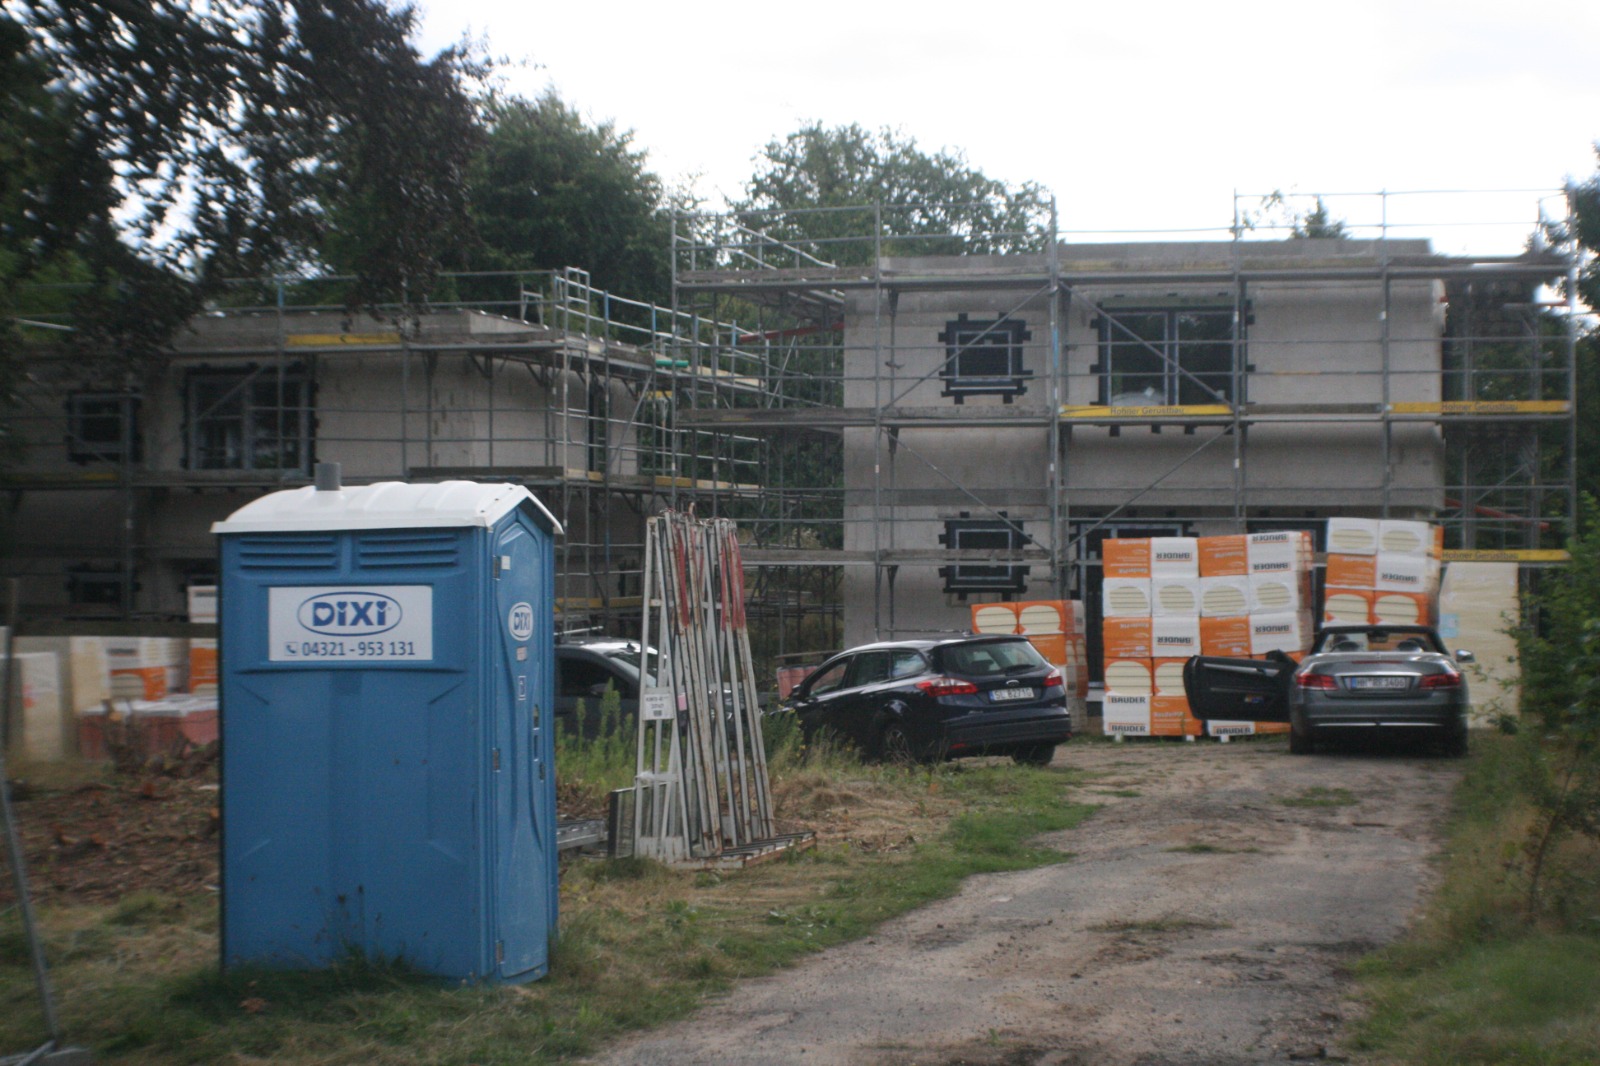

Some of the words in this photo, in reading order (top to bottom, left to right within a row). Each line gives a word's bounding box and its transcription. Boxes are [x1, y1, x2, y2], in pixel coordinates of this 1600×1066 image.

[1253, 562, 1289, 570] BAUDER
[1157, 636, 1191, 644] BAUDER
[302, 641, 346, 656] 04321
[358, 641, 384, 656] 953
[389, 641, 415, 656] 131
[1111, 696, 1146, 704] BAUDER
